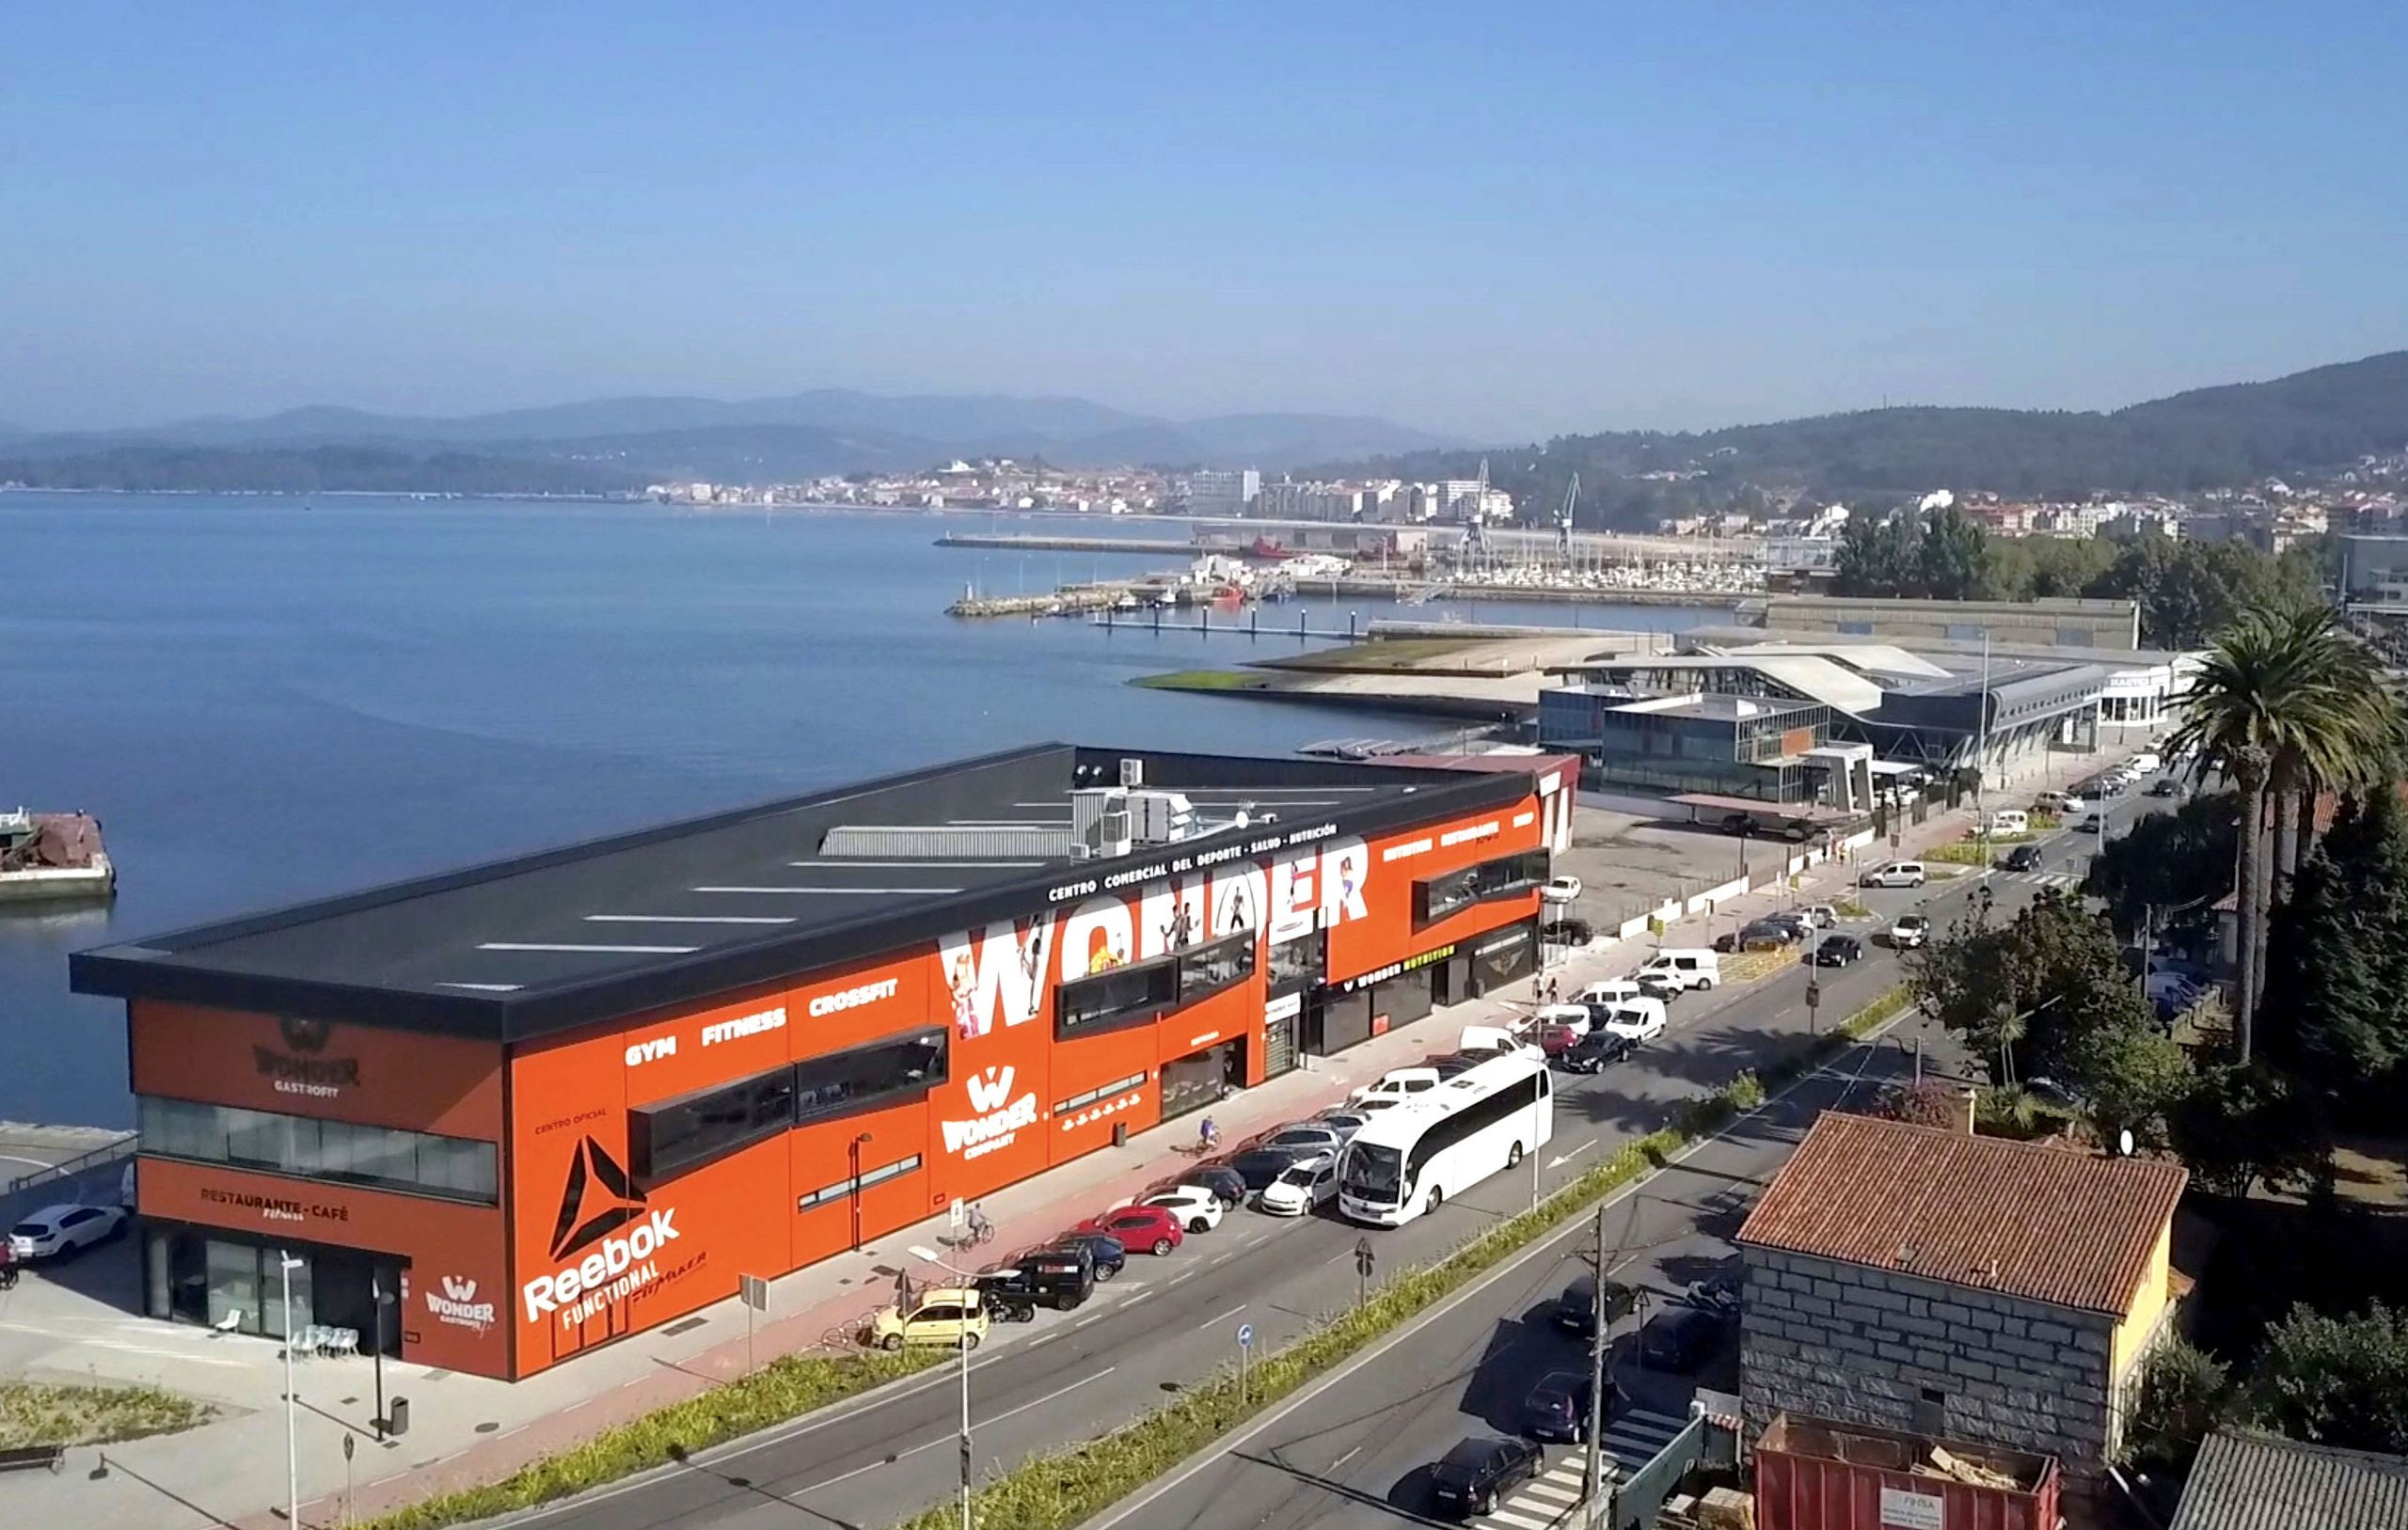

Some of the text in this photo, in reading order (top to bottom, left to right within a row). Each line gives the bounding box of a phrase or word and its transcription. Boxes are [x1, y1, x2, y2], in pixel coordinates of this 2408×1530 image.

[1048, 880, 1097, 903] CENTRO
[1104, 863, 1167, 889] COMERCIAL
[1173, 858, 1193, 872] DEL
[1196, 845, 1242, 866] DEPORTE
[1250, 837, 1281, 853] SALUD
[1289, 824, 1337, 845] NUTRICIÓN
[938, 835, 1369, 1040] WONDER
[1403, 945, 1455, 971] NUTRITION
[626, 978, 897, 1066] GYM FITNESS CROSSFIT
[251, 1044, 360, 1087] WONDER
[273, 1080, 340, 1098] GASTROFIT
[534, 1108, 608, 1135] CENTRO OFICIAL
[942, 1092, 1038, 1154] WONDER
[963, 1131, 1016, 1160] COMPANY
[200, 1189, 301, 1214] RESTAURANTE
[312, 1206, 349, 1221] CAFÉ
[523, 1207, 680, 1323] Reebok
[425, 1291, 495, 1323] WONDER
[562, 1260, 659, 1331] FUNCTIONAL
